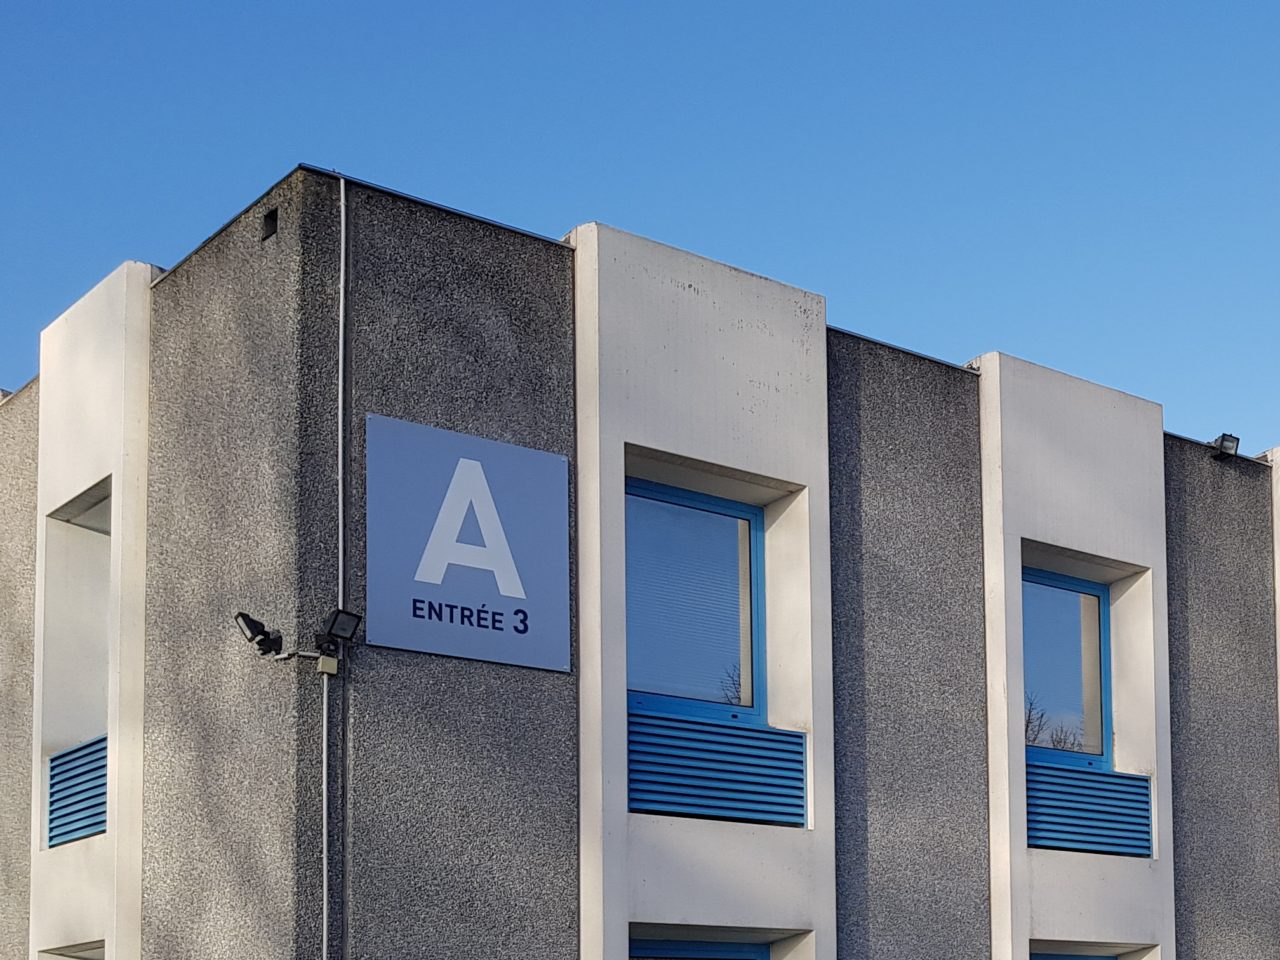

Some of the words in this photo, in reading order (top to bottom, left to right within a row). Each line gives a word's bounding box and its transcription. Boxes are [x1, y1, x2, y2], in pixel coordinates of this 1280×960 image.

[414, 457, 527, 599] A
[411, 597, 504, 631] ENTRÉE
[512, 608, 529, 634] 3
